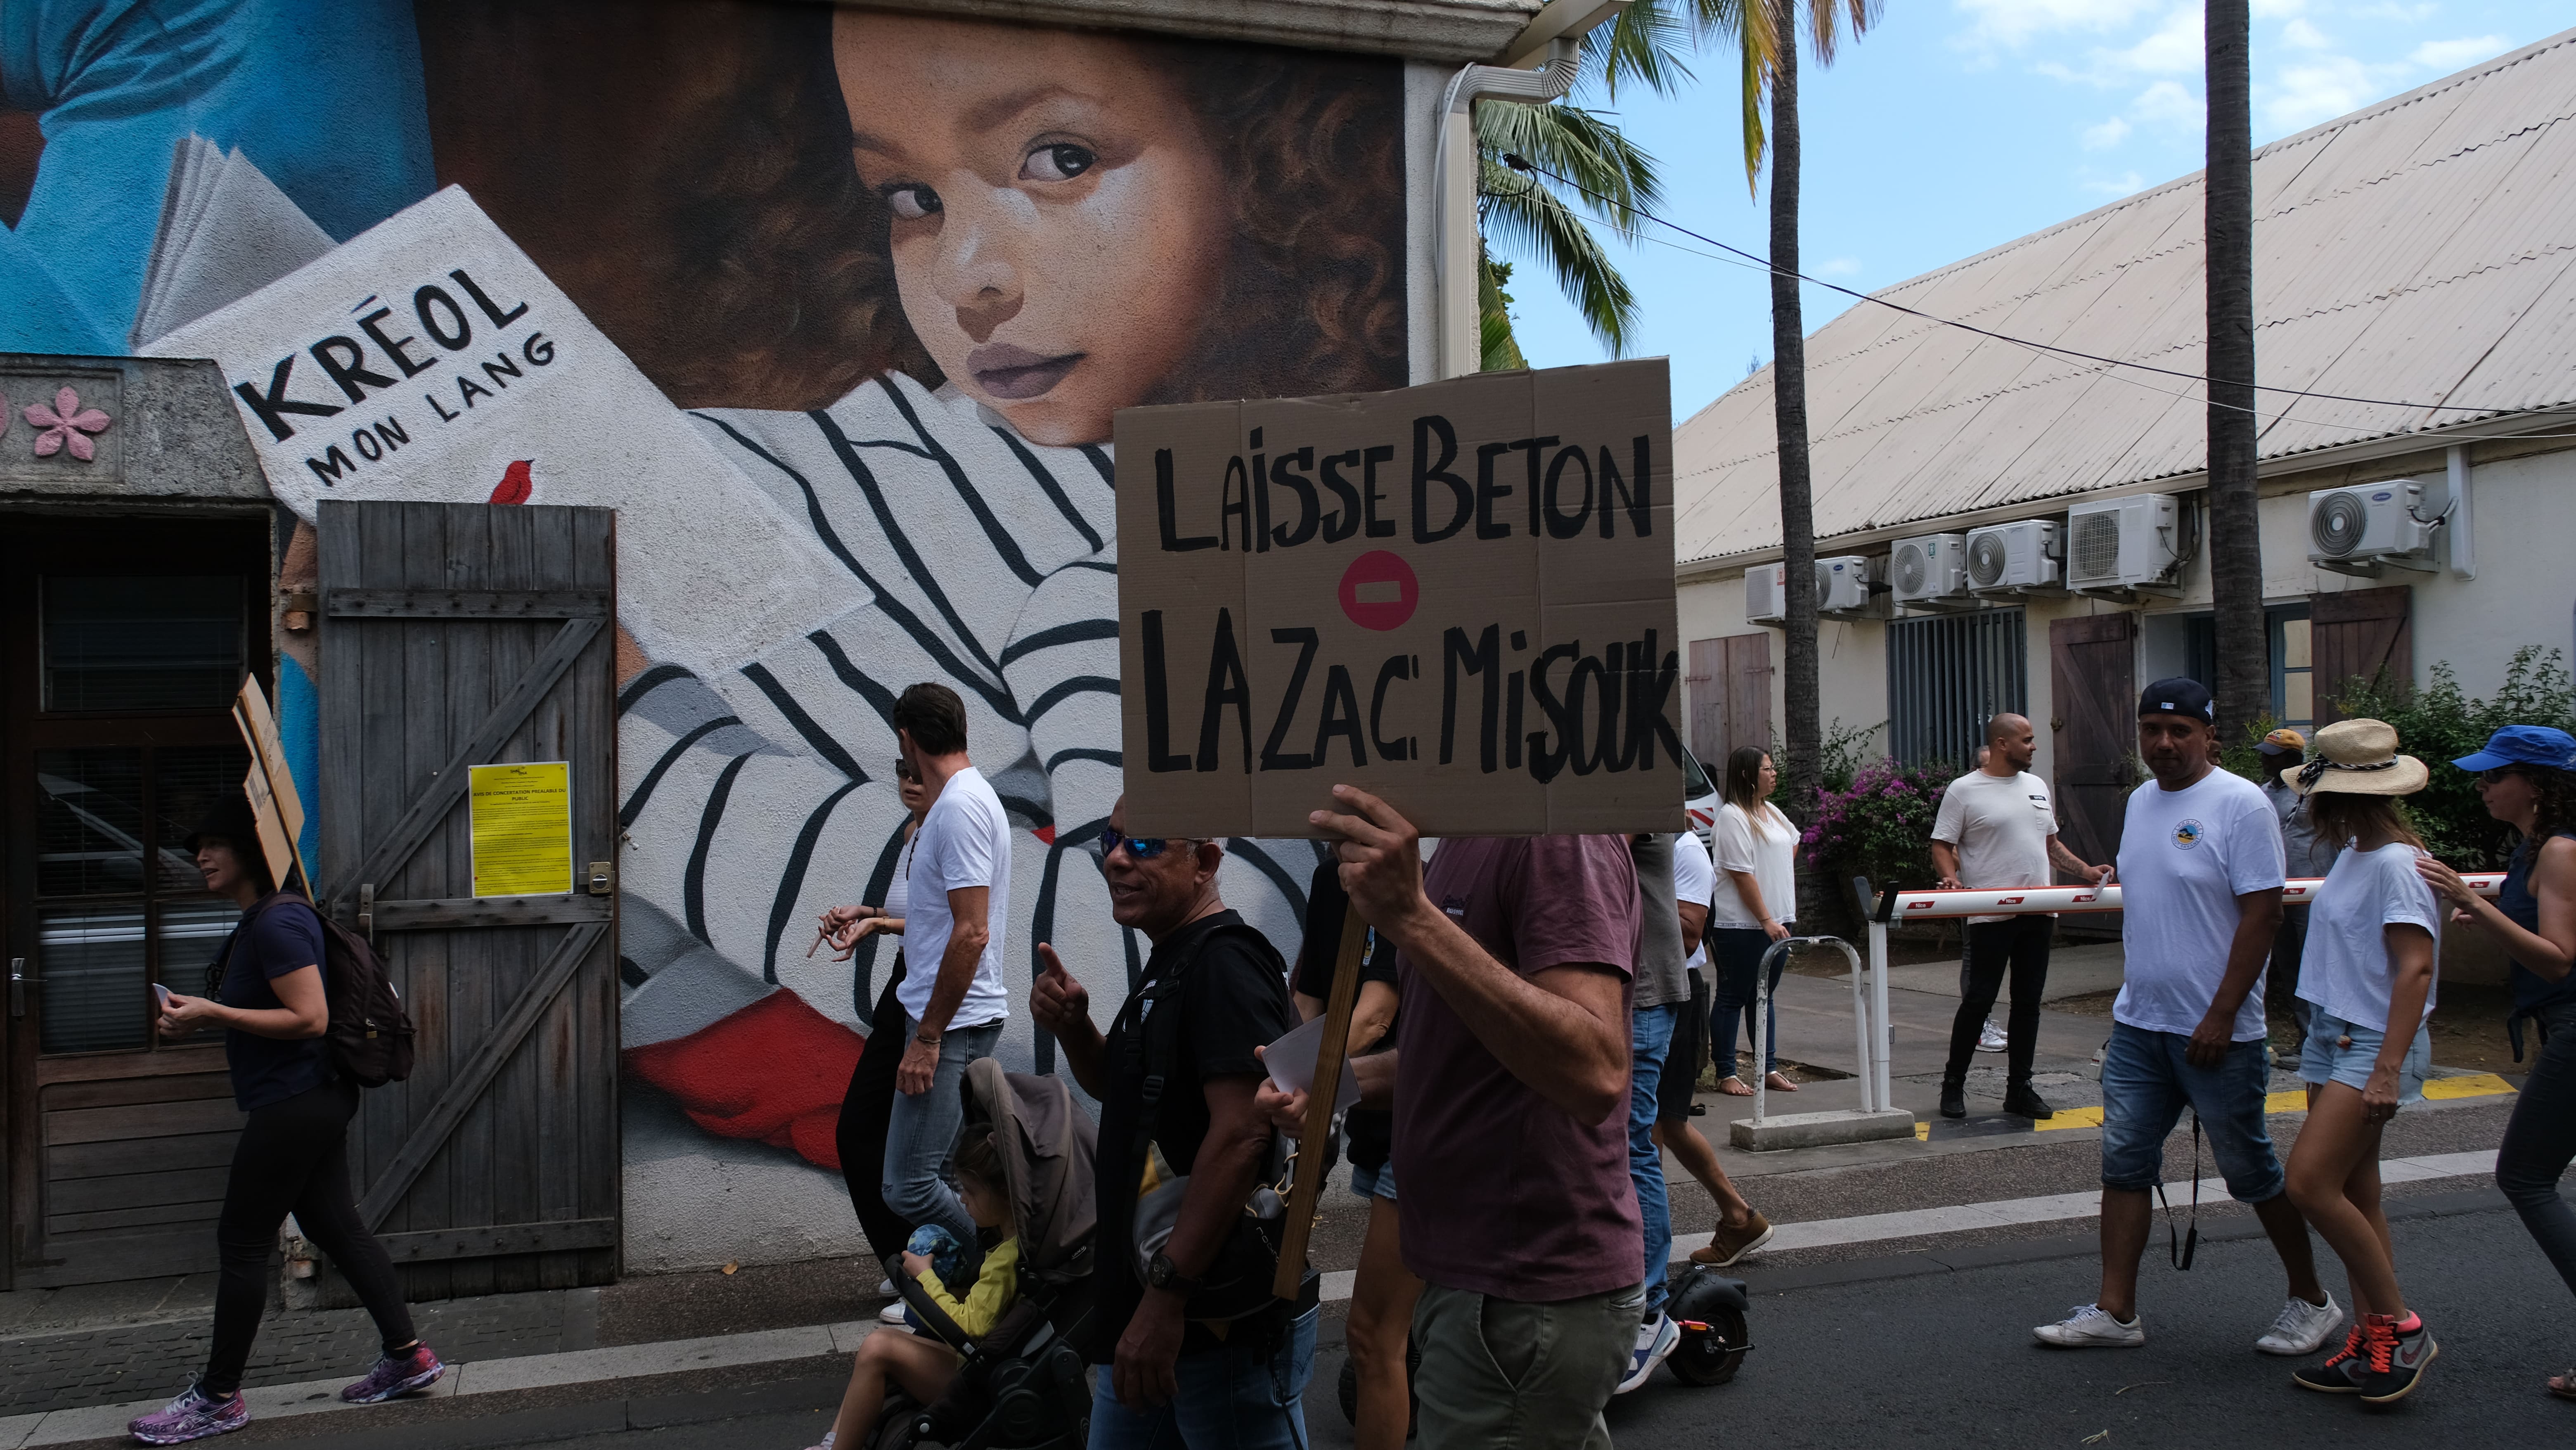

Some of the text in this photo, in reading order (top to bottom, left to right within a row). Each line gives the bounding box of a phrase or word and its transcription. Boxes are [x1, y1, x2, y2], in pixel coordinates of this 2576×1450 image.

[306, 332, 556, 486] MON LANG
[1411, 415, 1653, 545] BETON
